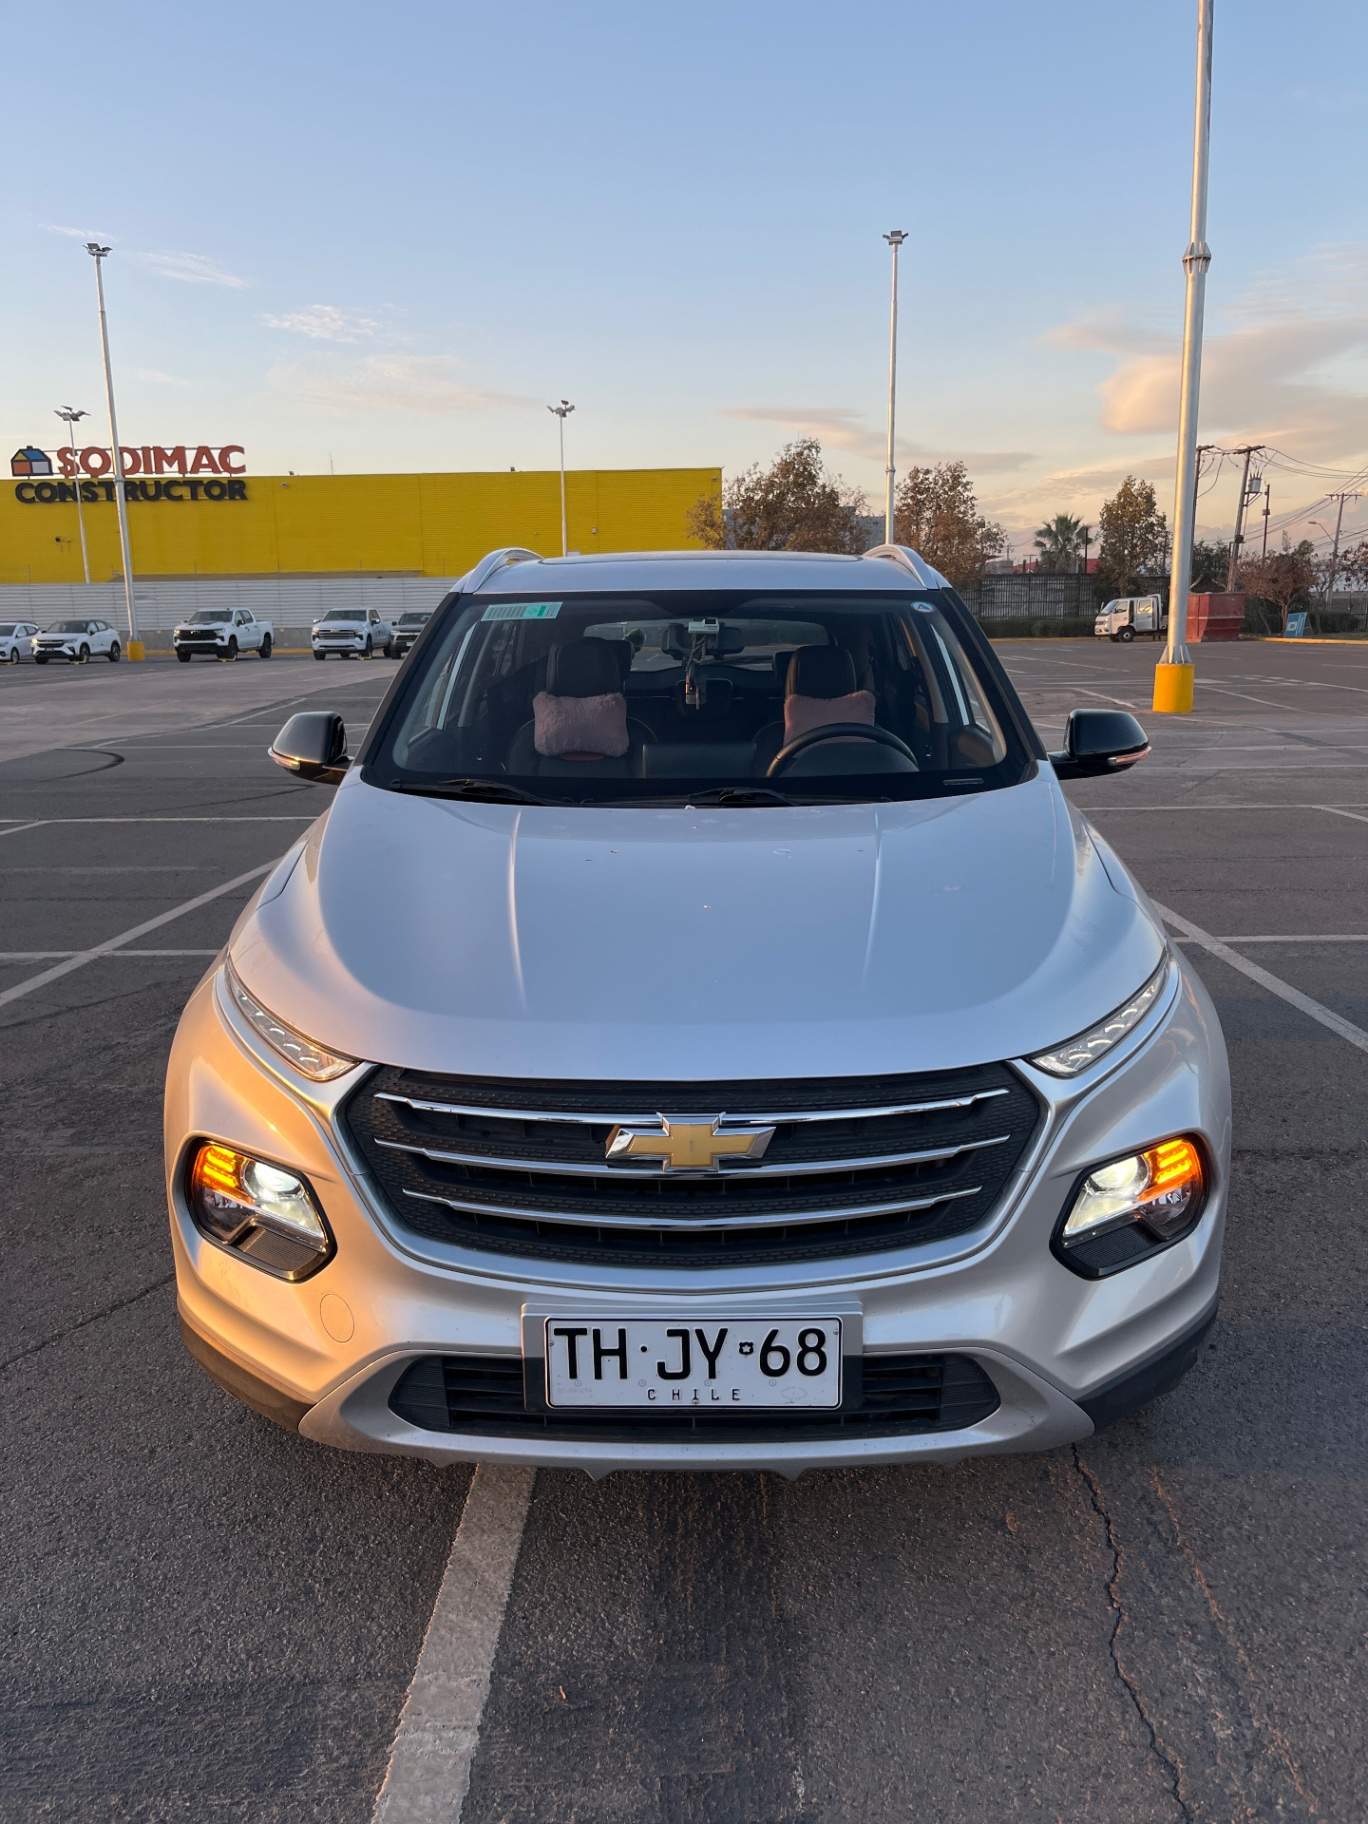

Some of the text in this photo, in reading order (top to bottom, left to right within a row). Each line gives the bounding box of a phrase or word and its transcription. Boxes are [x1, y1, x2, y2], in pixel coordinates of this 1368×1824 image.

[57, 445, 247, 477] SODIMAC
[15, 480, 248, 504] CONSTRUCTOR
[647, 1388, 742, 1402] CHILE
